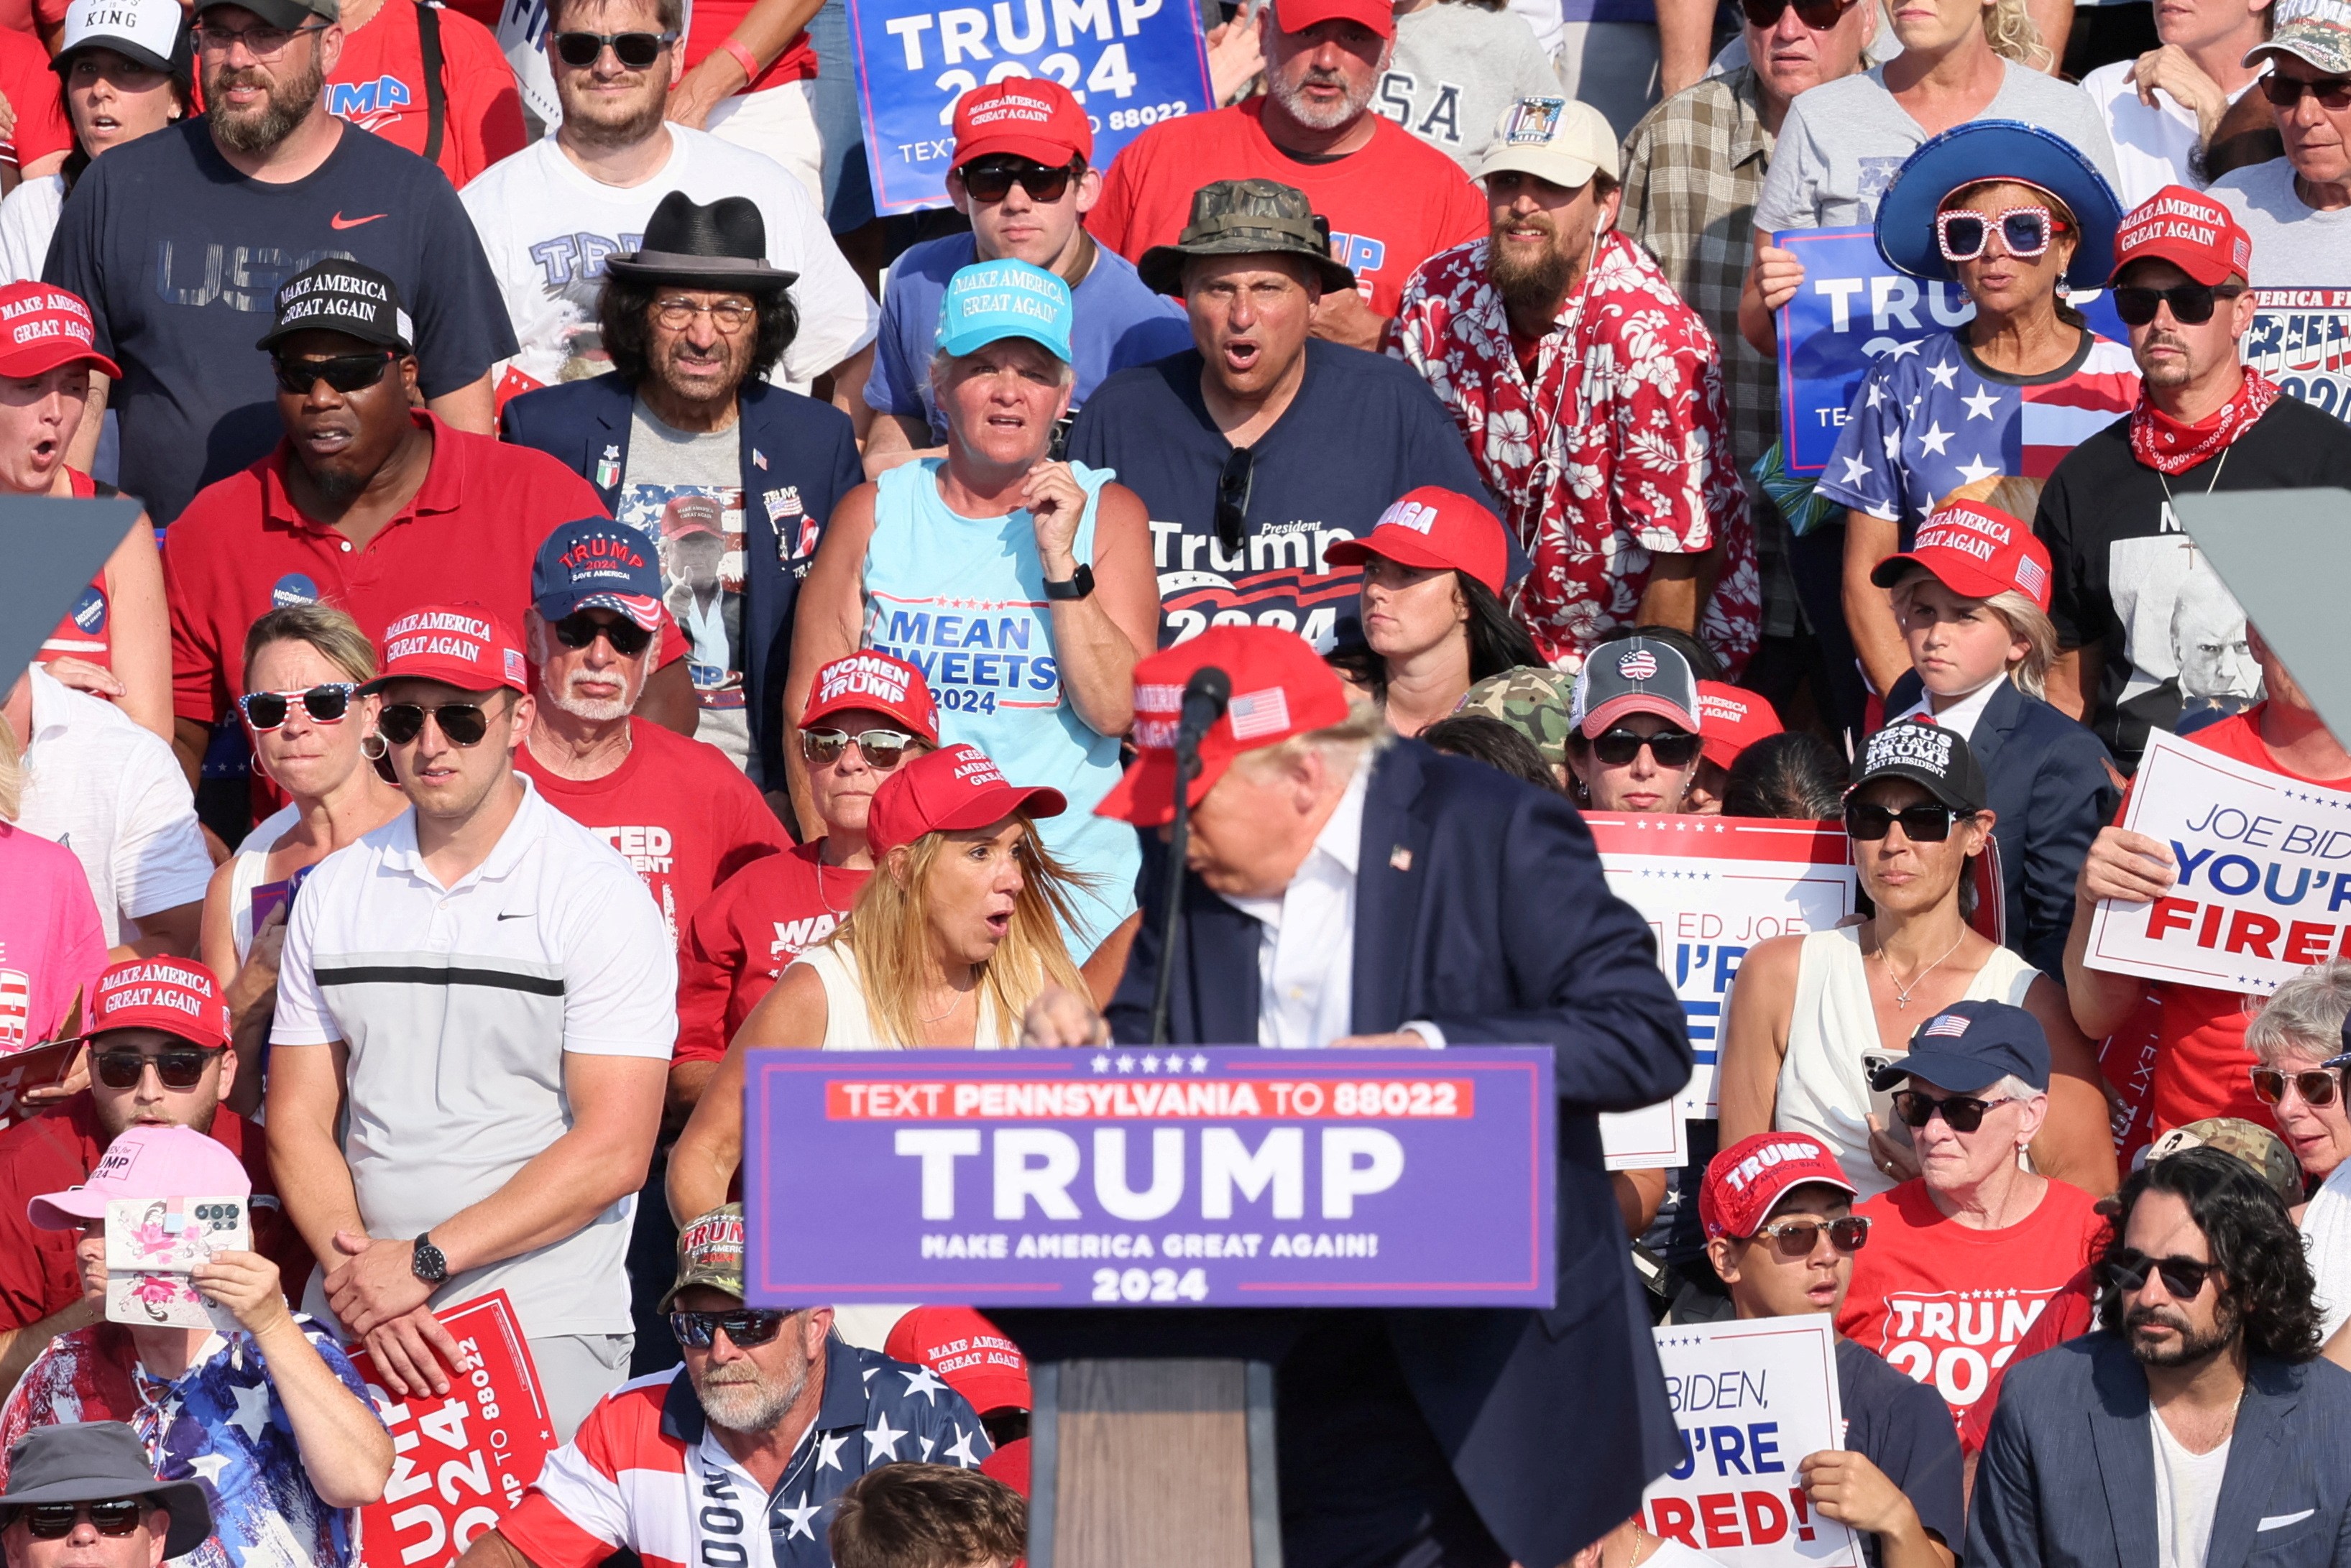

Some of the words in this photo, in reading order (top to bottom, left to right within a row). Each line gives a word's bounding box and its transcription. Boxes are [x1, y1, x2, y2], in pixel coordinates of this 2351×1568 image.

[85, 10, 137, 28] KING
[885, 0, 1164, 70] TRUMP
[935, 43, 1137, 126] 224
[967, 98, 1000, 116] MAKE
[998, 95, 1054, 114] AMERICA
[971, 109, 1007, 126] GREAT
[1007, 109, 1048, 122] AGAIN
[1109, 101, 1188, 132] 88022
[1375, 70, 1465, 146] SA
[2117, 203, 2155, 234] MAKE
[2154, 198, 2227, 228] AMERICA
[2122, 221, 2164, 252] GREAT
[2165, 221, 2216, 247] AGAIN
[158, 240, 359, 313] US
[281, 277, 312, 308] MAKE
[313, 274, 387, 302] AMERICA
[954, 270, 999, 295] MAKE
[1000, 269, 1065, 305] AMERICA
[0, 296, 44, 320] MAKE
[281, 298, 323, 326] GREAT
[324, 298, 377, 323] AGAIN
[963, 294, 1011, 318] GREAT
[1012, 295, 1058, 323] AGAIN
[13, 319, 60, 343] GREAT
[1261, 520, 1321, 535] President
[1941, 508, 2011, 545] AMERICA
[558, 538, 645, 569] TRUMP
[1941, 532, 1996, 562] AGAIN
[573, 571, 592, 581] SAVE
[593, 570, 630, 580] AMERICA!
[585, 559, 617, 571] 2024
[384, 613, 418, 642] MAKE
[417, 612, 491, 642] AMERICA
[888, 610, 1031, 651] MEAN
[387, 636, 427, 663] GREAT
[426, 636, 480, 663] AGAIN
[822, 655, 911, 688] WOMEN
[819, 675, 906, 704] TRUMP
[931, 687, 996, 716] 2024
[1703, 706, 1742, 723] AGAIN
[1869, 724, 1953, 748] JESUS
[1877, 737, 1899, 750] MY
[1901, 736, 1950, 757] SAVIOR
[1864, 763, 1872, 775] IS
[1872, 758, 1888, 770] MY
[1888, 755, 1946, 779] PRESIDENT
[1866, 743, 1951, 767] TRUMP
[970, 771, 1004, 786] GREA
[2186, 803, 2281, 848] JOE
[589, 825, 673, 857] TED
[99, 965, 142, 993] MAKE
[140, 964, 212, 998] AMERICA
[105, 988, 152, 1014] GREAT
[152, 989, 201, 1018] AGAIN
[842, 1082, 945, 1117] TEXT
[954, 1082, 1261, 1117] PENNSYLVANIA
[1269, 1082, 1325, 1116] TO
[1333, 1082, 1458, 1116] 88022
[893, 1126, 1405, 1222] TRUMP
[1726, 1143, 1821, 1193] TRUMP
[921, 1233, 1008, 1260] MAKE
[1015, 1233, 1154, 1260] AMERICA
[1161, 1233, 1263, 1259] GREAT
[1269, 1233, 1379, 1258] AGAIN!
[1091, 1268, 1210, 1303] 2024
[927, 1339, 969, 1361] MAKE
[971, 1336, 1021, 1355] AMERICA
[938, 1352, 983, 1374] GREAT
[987, 1352, 1020, 1369] AGAIN
[459, 1336, 500, 1421] 88022
[1665, 1369, 1768, 1413] BIDEN,
[490, 1429, 512, 1467] TO
